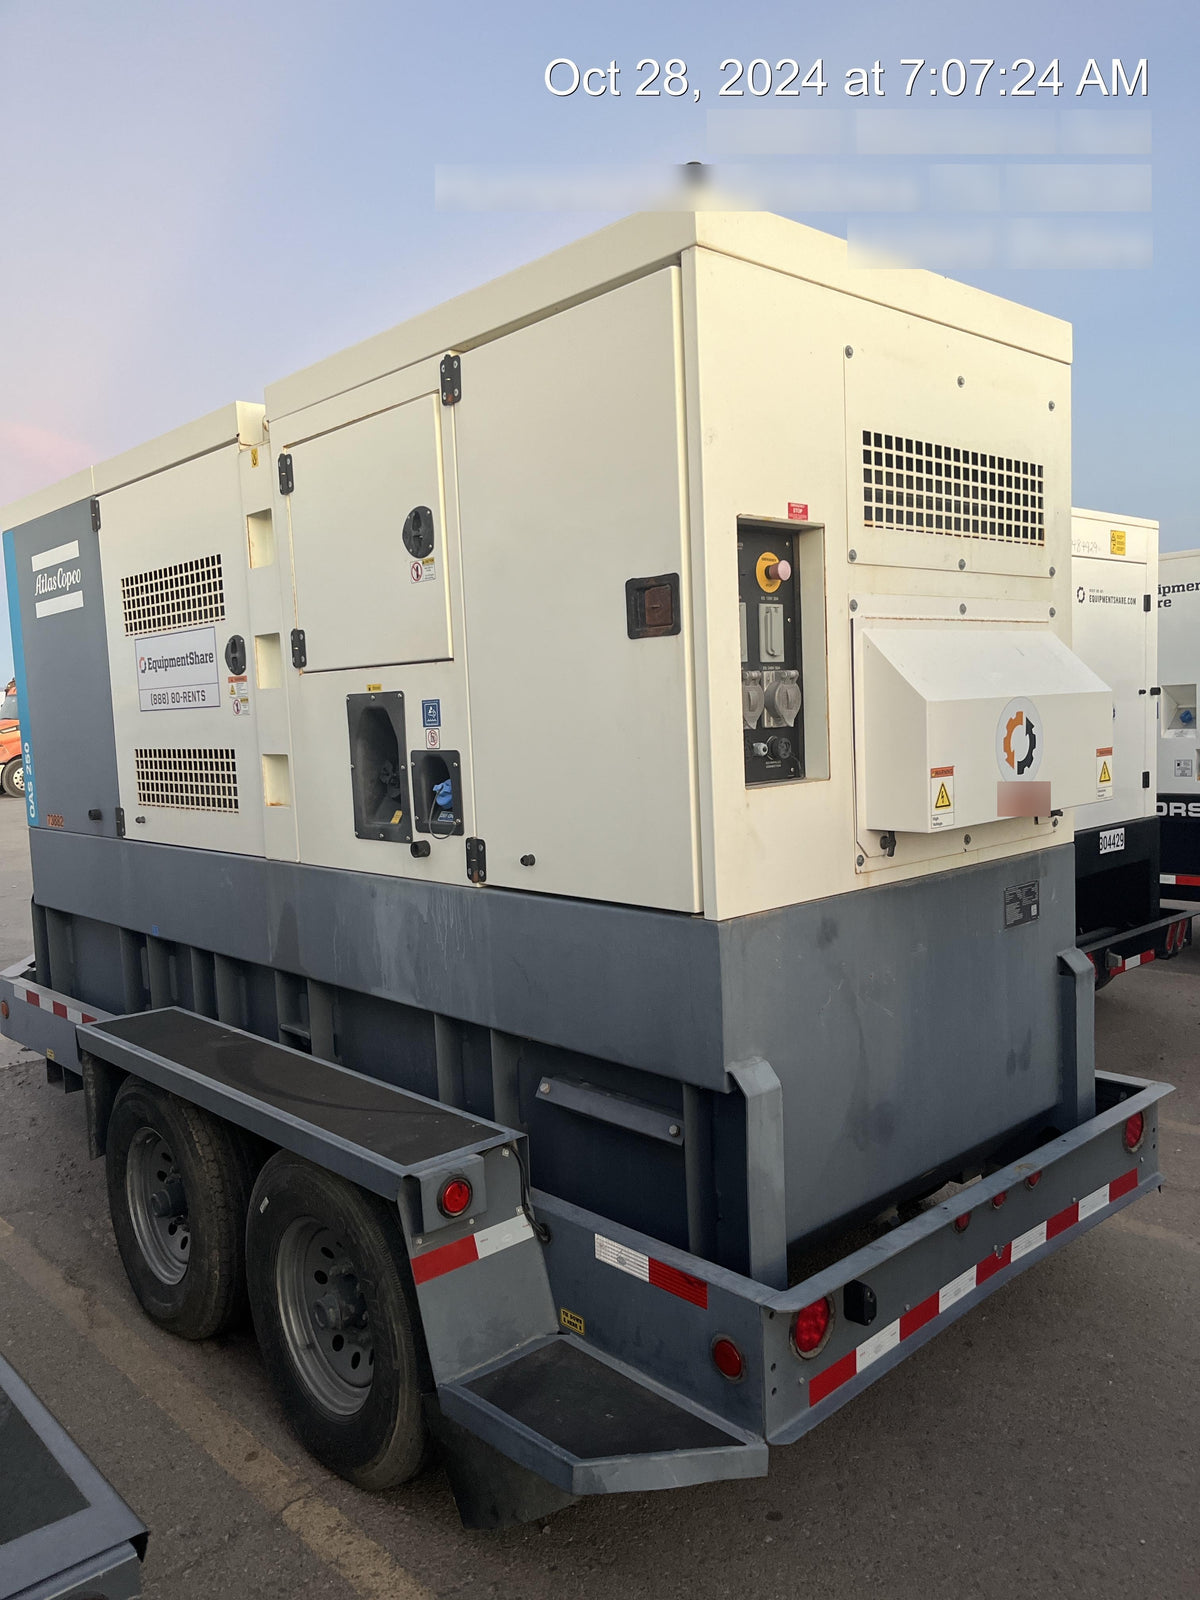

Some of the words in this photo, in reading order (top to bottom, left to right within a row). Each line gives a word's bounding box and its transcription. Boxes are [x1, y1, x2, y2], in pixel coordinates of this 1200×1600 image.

[34, 573, 57, 596] Atlas
[57, 567, 82, 591] Copco
[147, 651, 214, 673] EquipmentShare
[150, 691, 169, 706] (888)
[23, 742, 32, 776] 250
